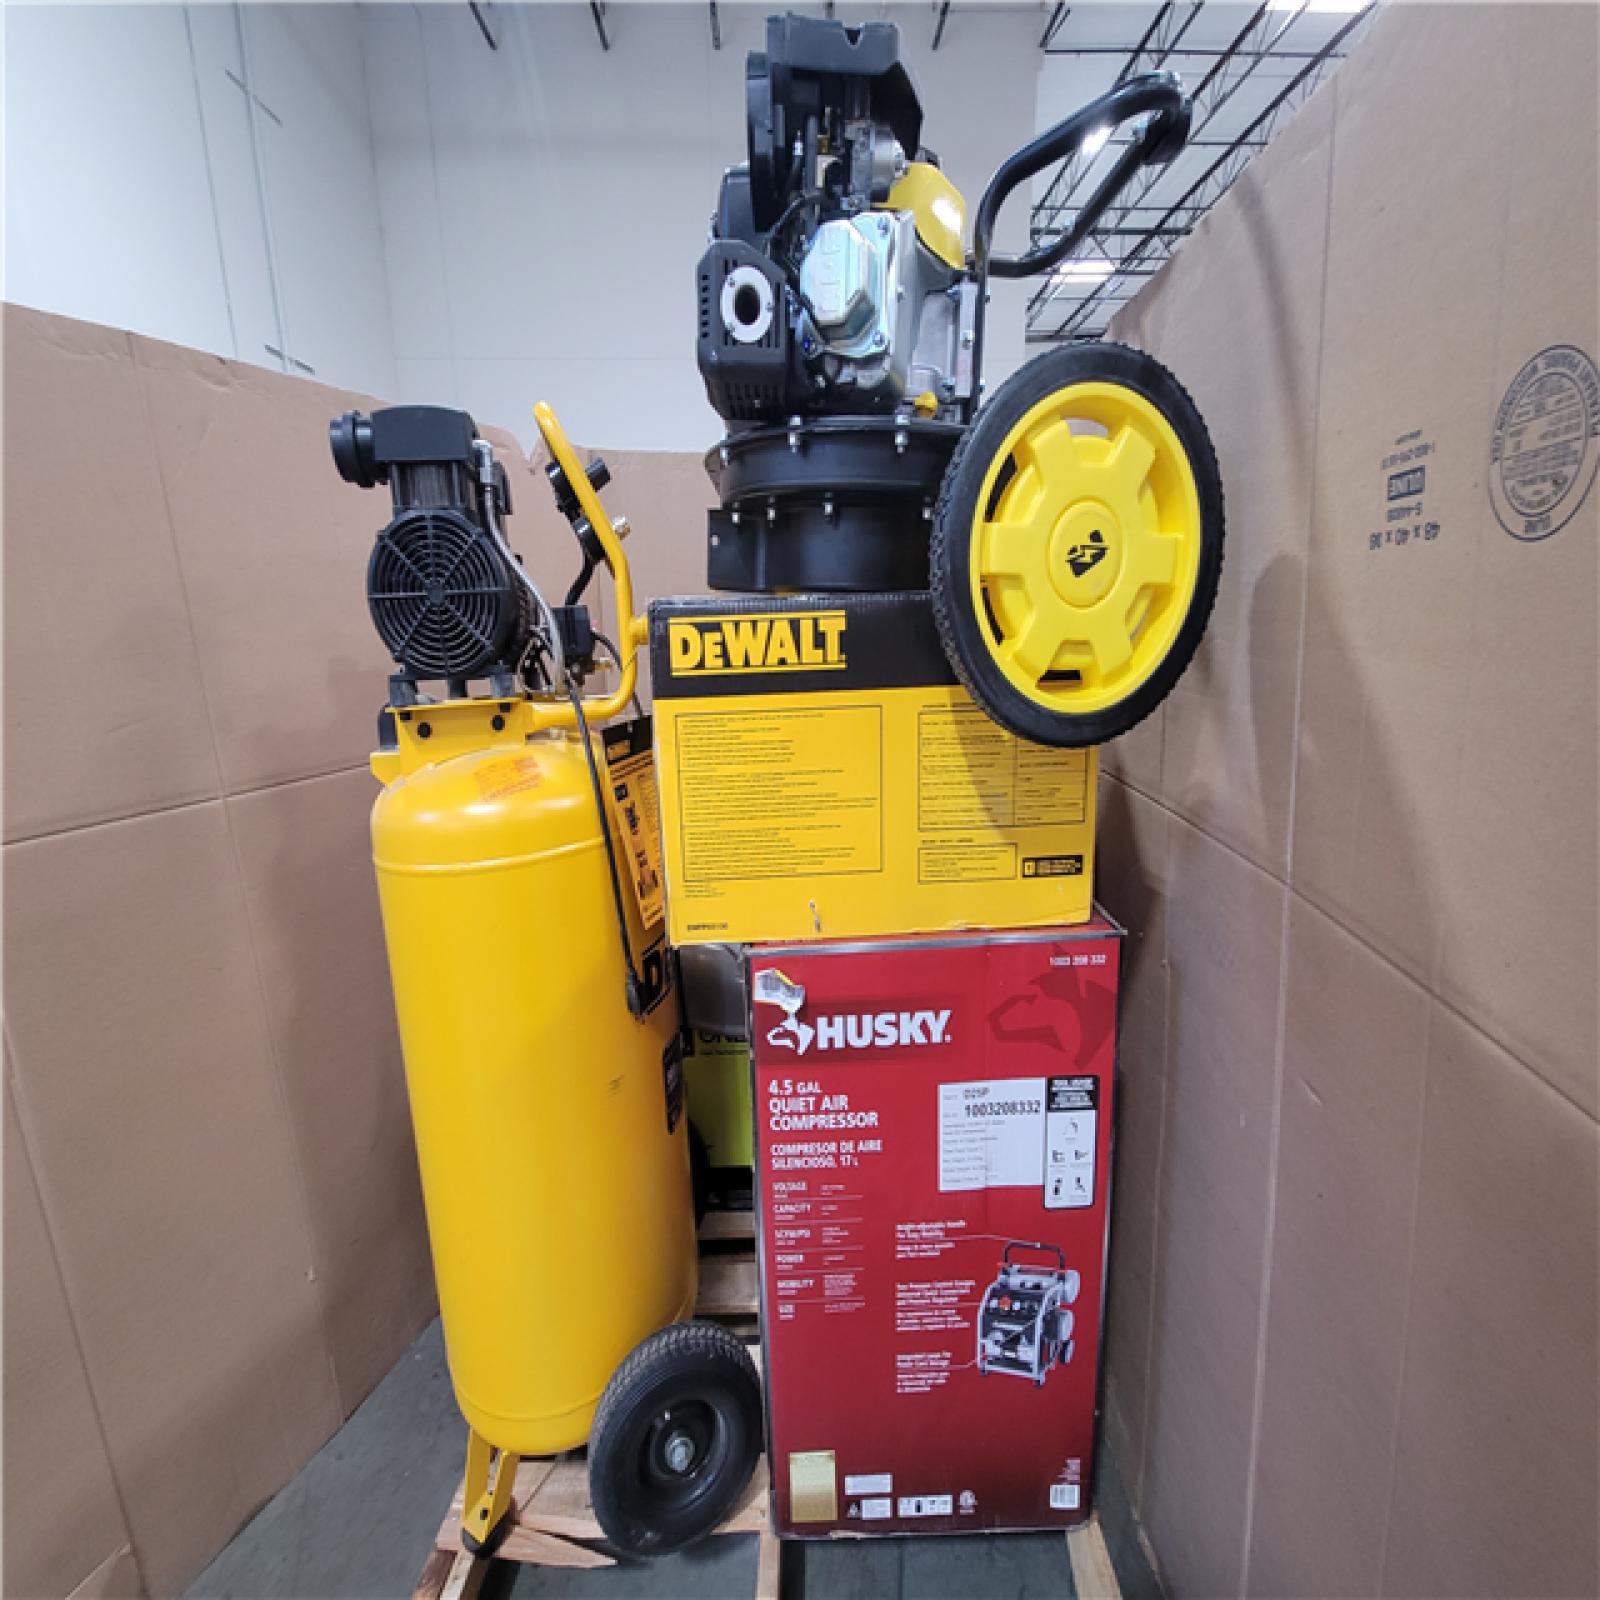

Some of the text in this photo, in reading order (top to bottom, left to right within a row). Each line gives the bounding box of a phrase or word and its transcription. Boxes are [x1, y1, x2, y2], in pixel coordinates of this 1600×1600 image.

[769, 1080, 822, 1095] 4.5 GAL
[769, 1095, 848, 1113] QUIET AIR
[964, 1100, 1041, 1118] 1003208332
[769, 1112, 878, 1131] COMPRESSOR
[771, 1139, 883, 1156] COMPRESOR DE AIRE
